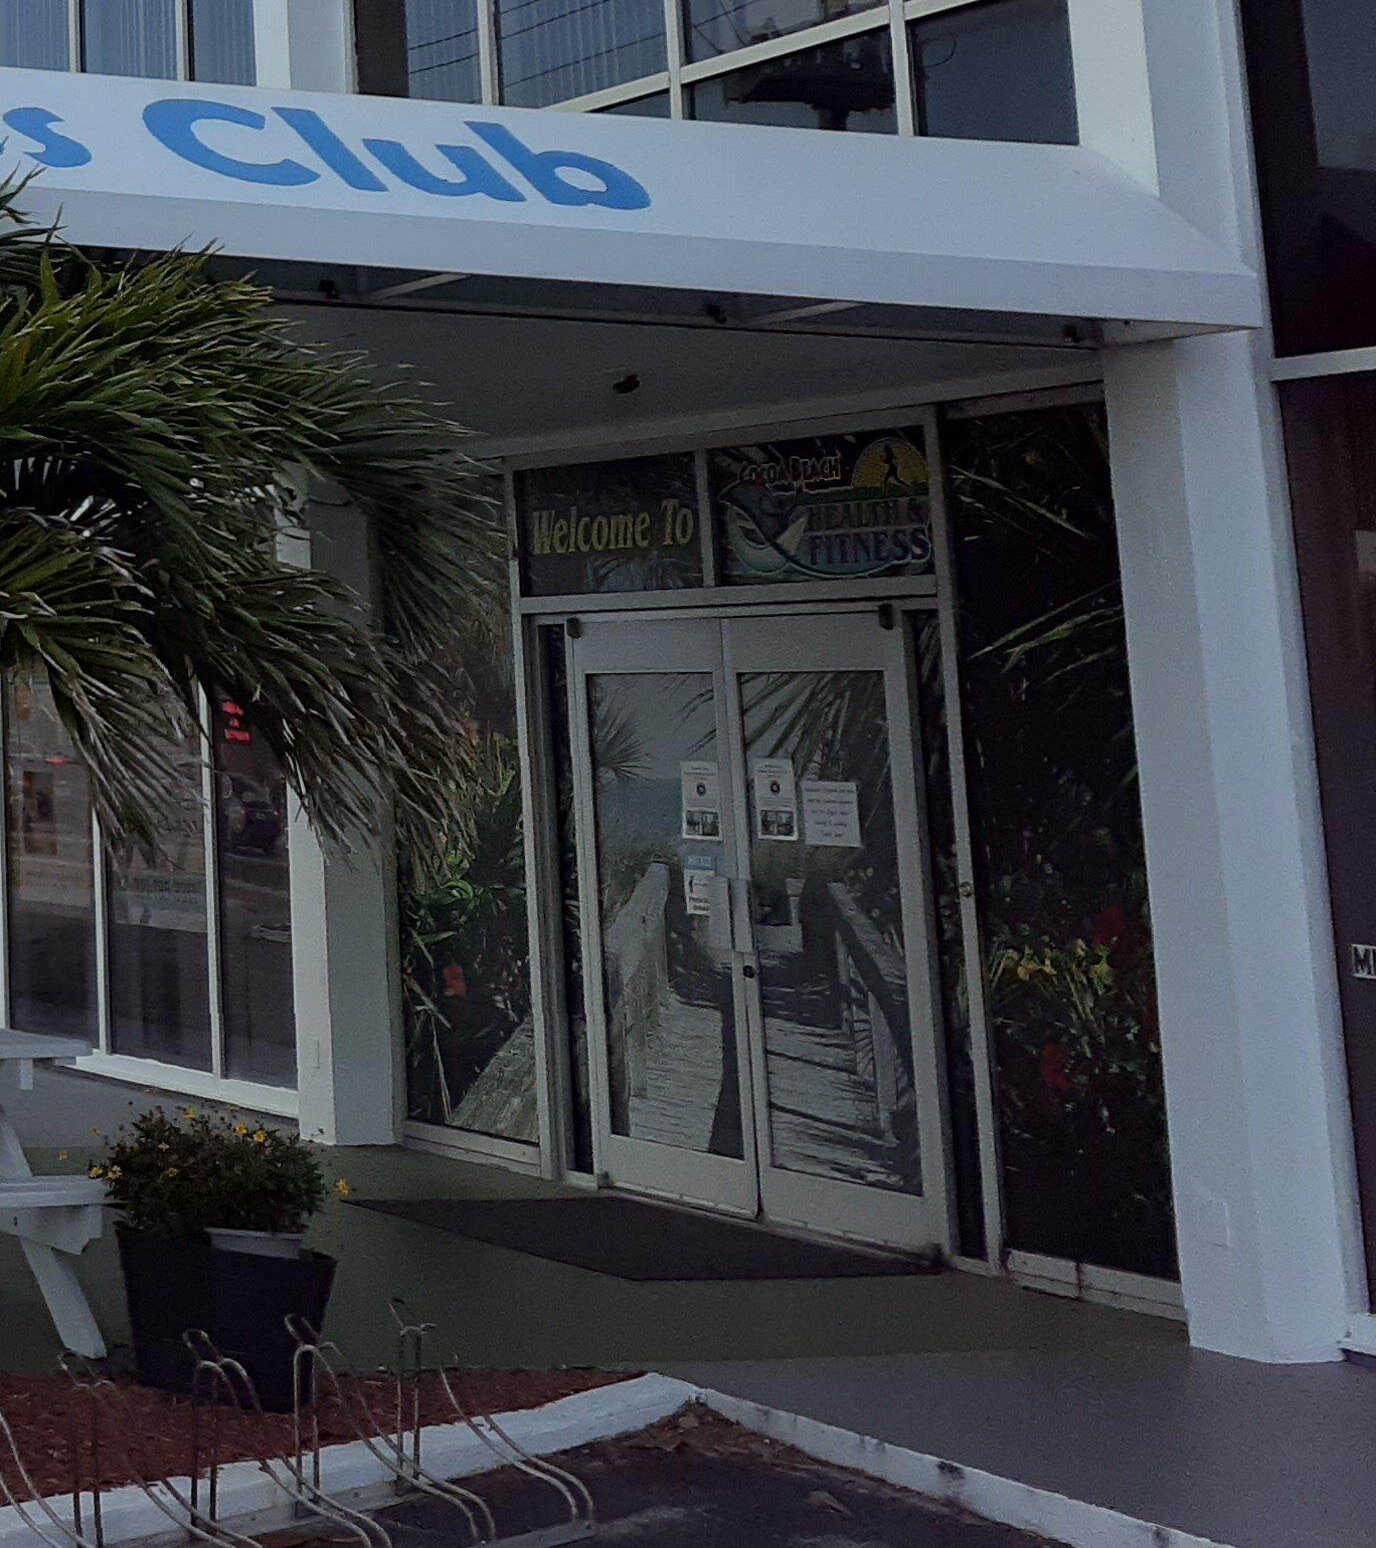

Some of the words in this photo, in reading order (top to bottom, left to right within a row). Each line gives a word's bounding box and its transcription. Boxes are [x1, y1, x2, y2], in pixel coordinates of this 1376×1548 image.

[140, 97, 652, 211] Club
[789, 455, 842, 481] BEACH
[531, 506, 650, 556] Welcome
[660, 498, 695, 547] To
[807, 529, 932, 567] FITNESS
